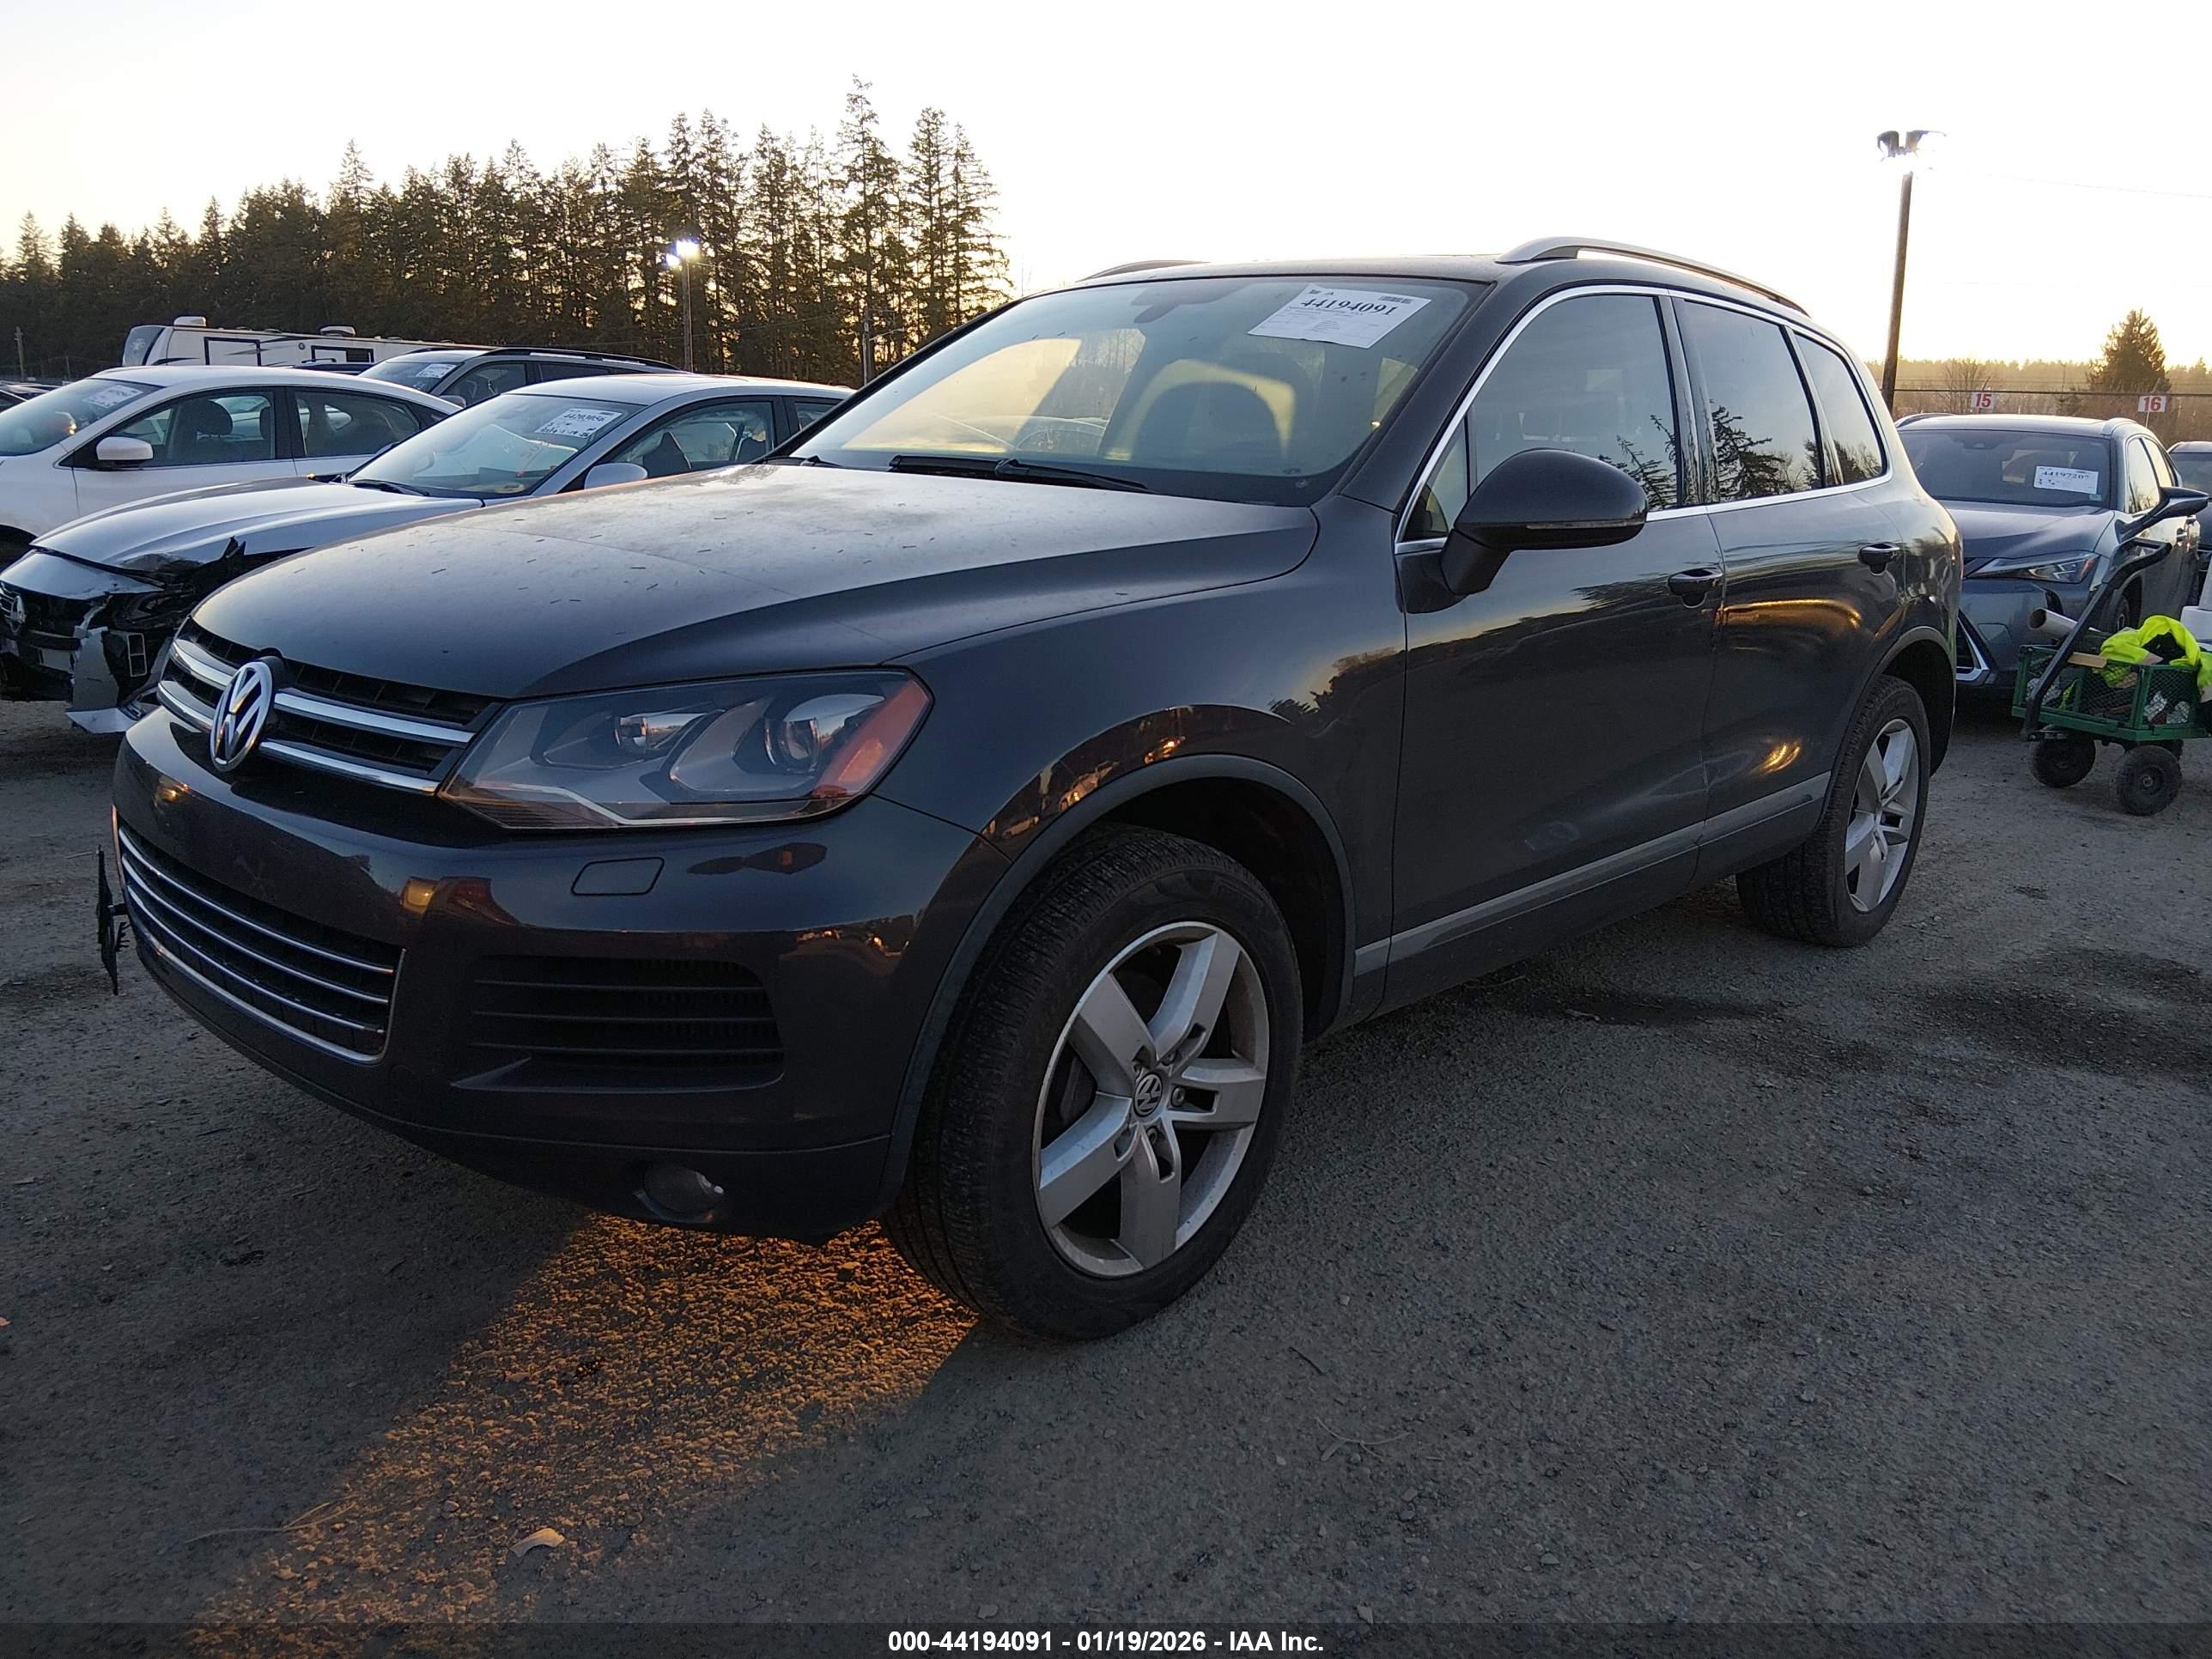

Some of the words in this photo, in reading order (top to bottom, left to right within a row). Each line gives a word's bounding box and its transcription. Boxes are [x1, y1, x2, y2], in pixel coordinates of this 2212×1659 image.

[1300, 298, 1399, 316] 44194091
[1975, 393, 1992, 408] 15
[2143, 397, 2162, 411] 16
